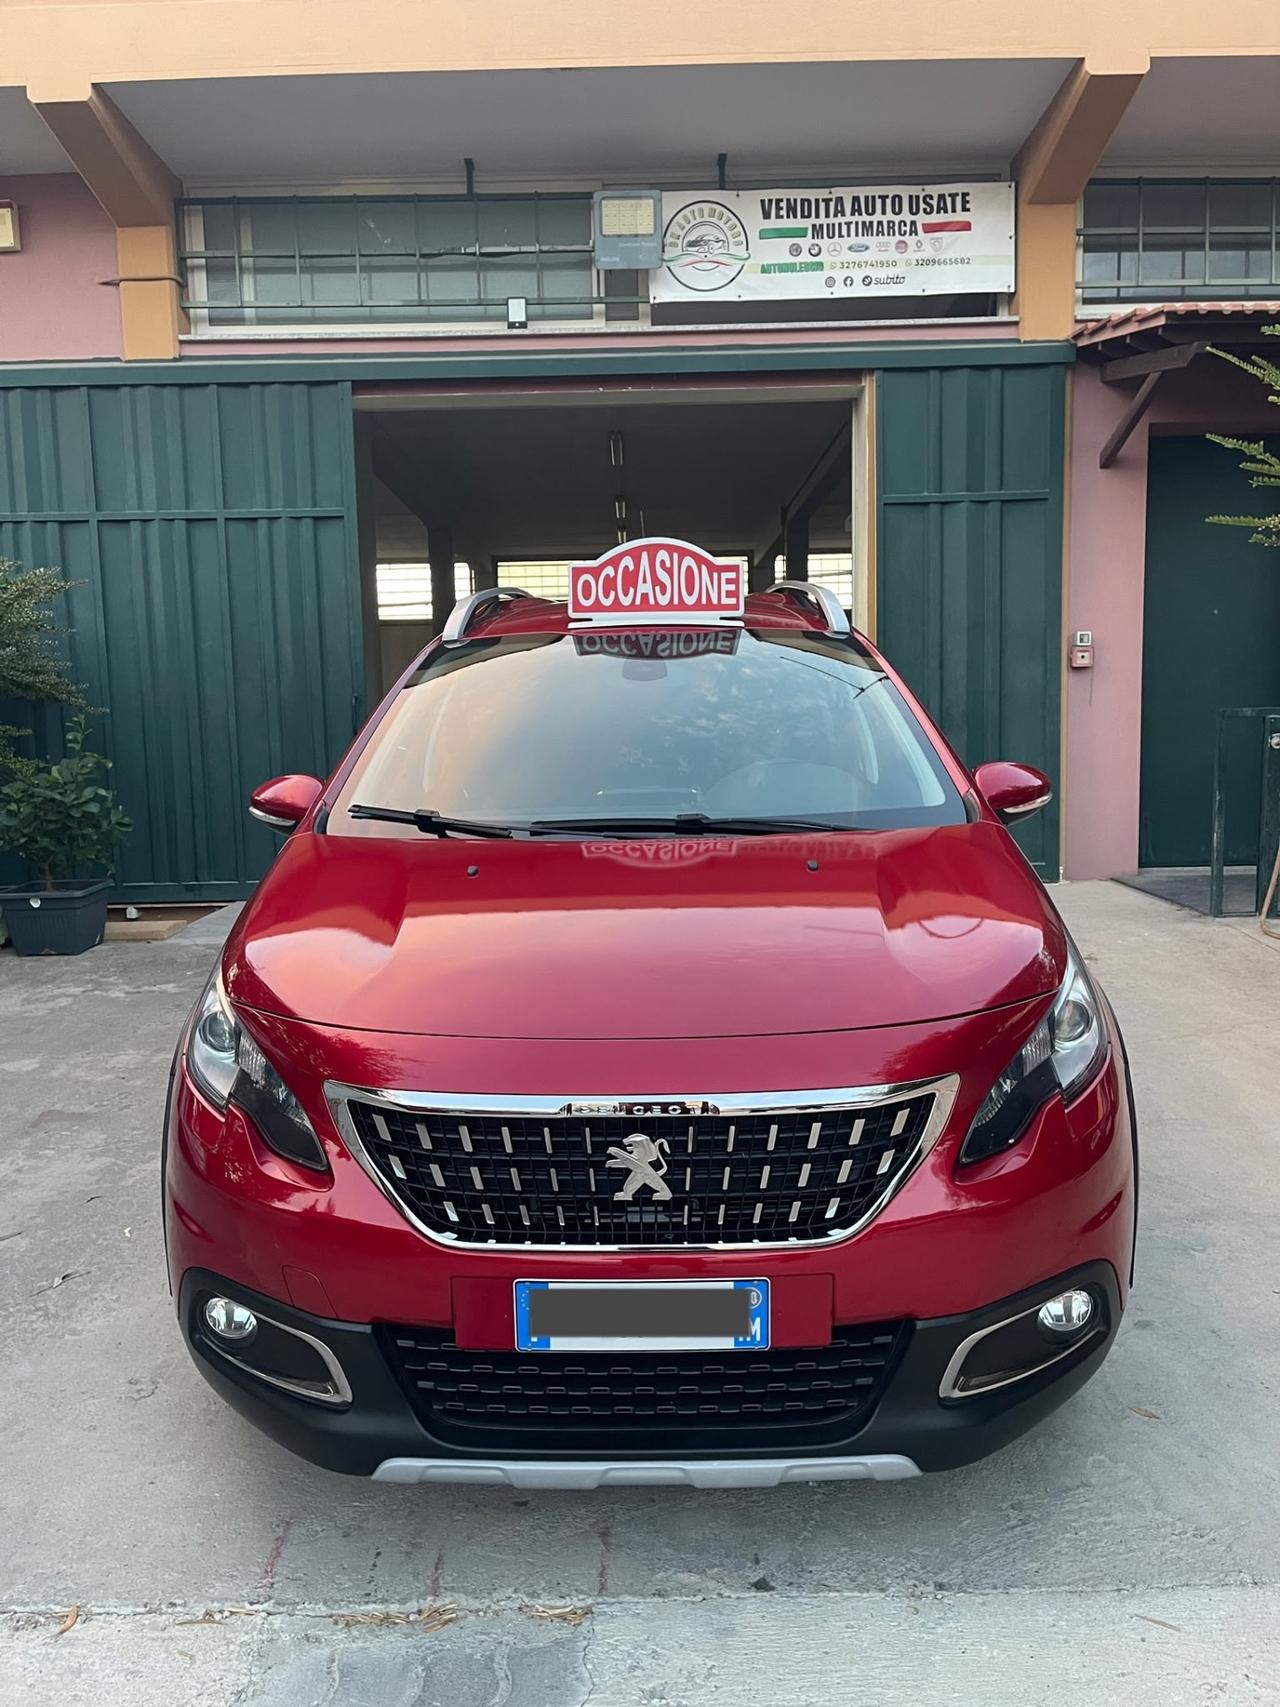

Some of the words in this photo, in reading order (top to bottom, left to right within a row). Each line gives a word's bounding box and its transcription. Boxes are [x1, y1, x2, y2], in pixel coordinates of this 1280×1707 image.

[759, 196, 846, 220] VENDITA
[850, 194, 903, 217] AUTO
[908, 192, 971, 216] USATE
[676, 207, 705, 231] AUTO
[708, 207, 744, 247] MOTORS
[811, 220, 919, 240] MULTIMARCA
[839, 260, 897, 270] 3276741950
[914, 257, 971, 267] 3209665682
[874, 275, 906, 286] subito
[576, 549, 737, 607] OCCASIONE
